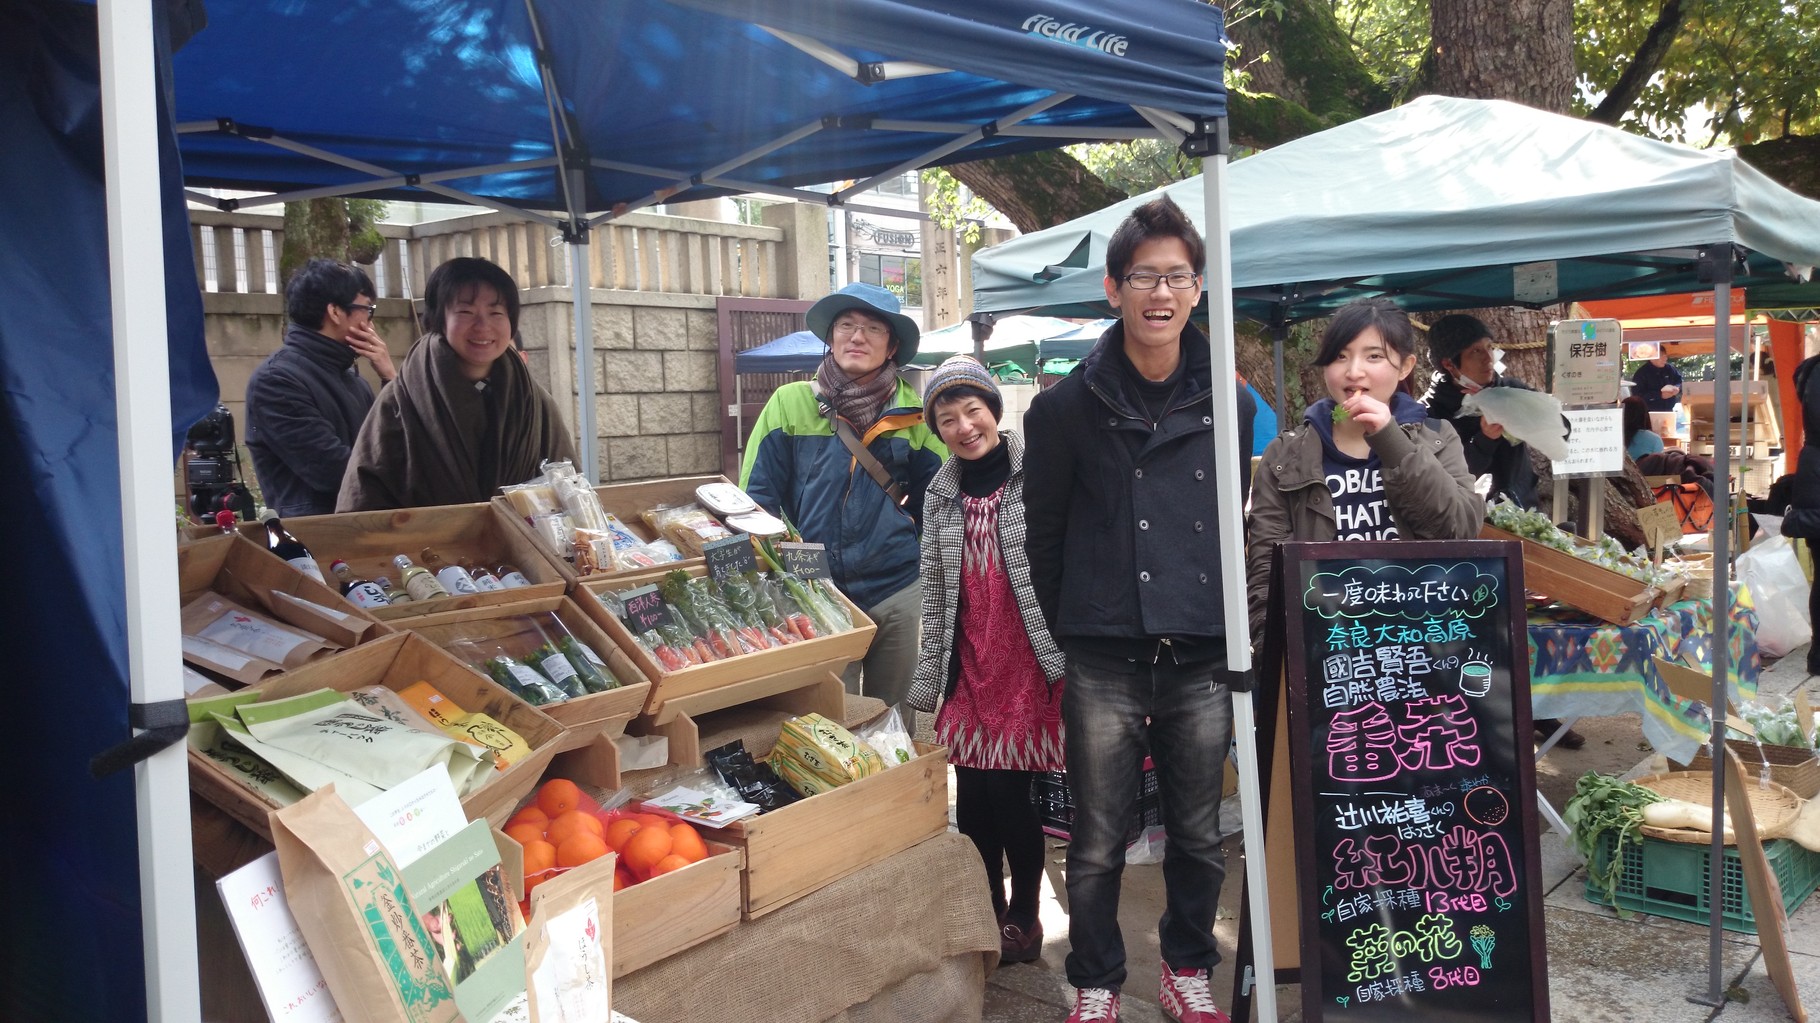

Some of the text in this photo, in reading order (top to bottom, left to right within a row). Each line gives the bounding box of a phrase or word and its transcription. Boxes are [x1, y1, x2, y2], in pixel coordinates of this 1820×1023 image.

[1021, 13, 1128, 57] Field Life
[877, 232, 912, 246] FUSION
[886, 284, 904, 293] YOGA
[1569, 342, 1607, 358] 保存樹
[1561, 371, 1582, 379] くすのき
[1332, 499, 1395, 530] HAT'
[1322, 578, 1470, 606] 一度味わって下さい
[1326, 618, 1476, 650] 奈良大和高原
[1323, 676, 1429, 709] 自然農法
[1326, 694, 1481, 782] 番茶
[1397, 821, 1446, 840] はっさく
[1346, 913, 1463, 982] 菜の花
